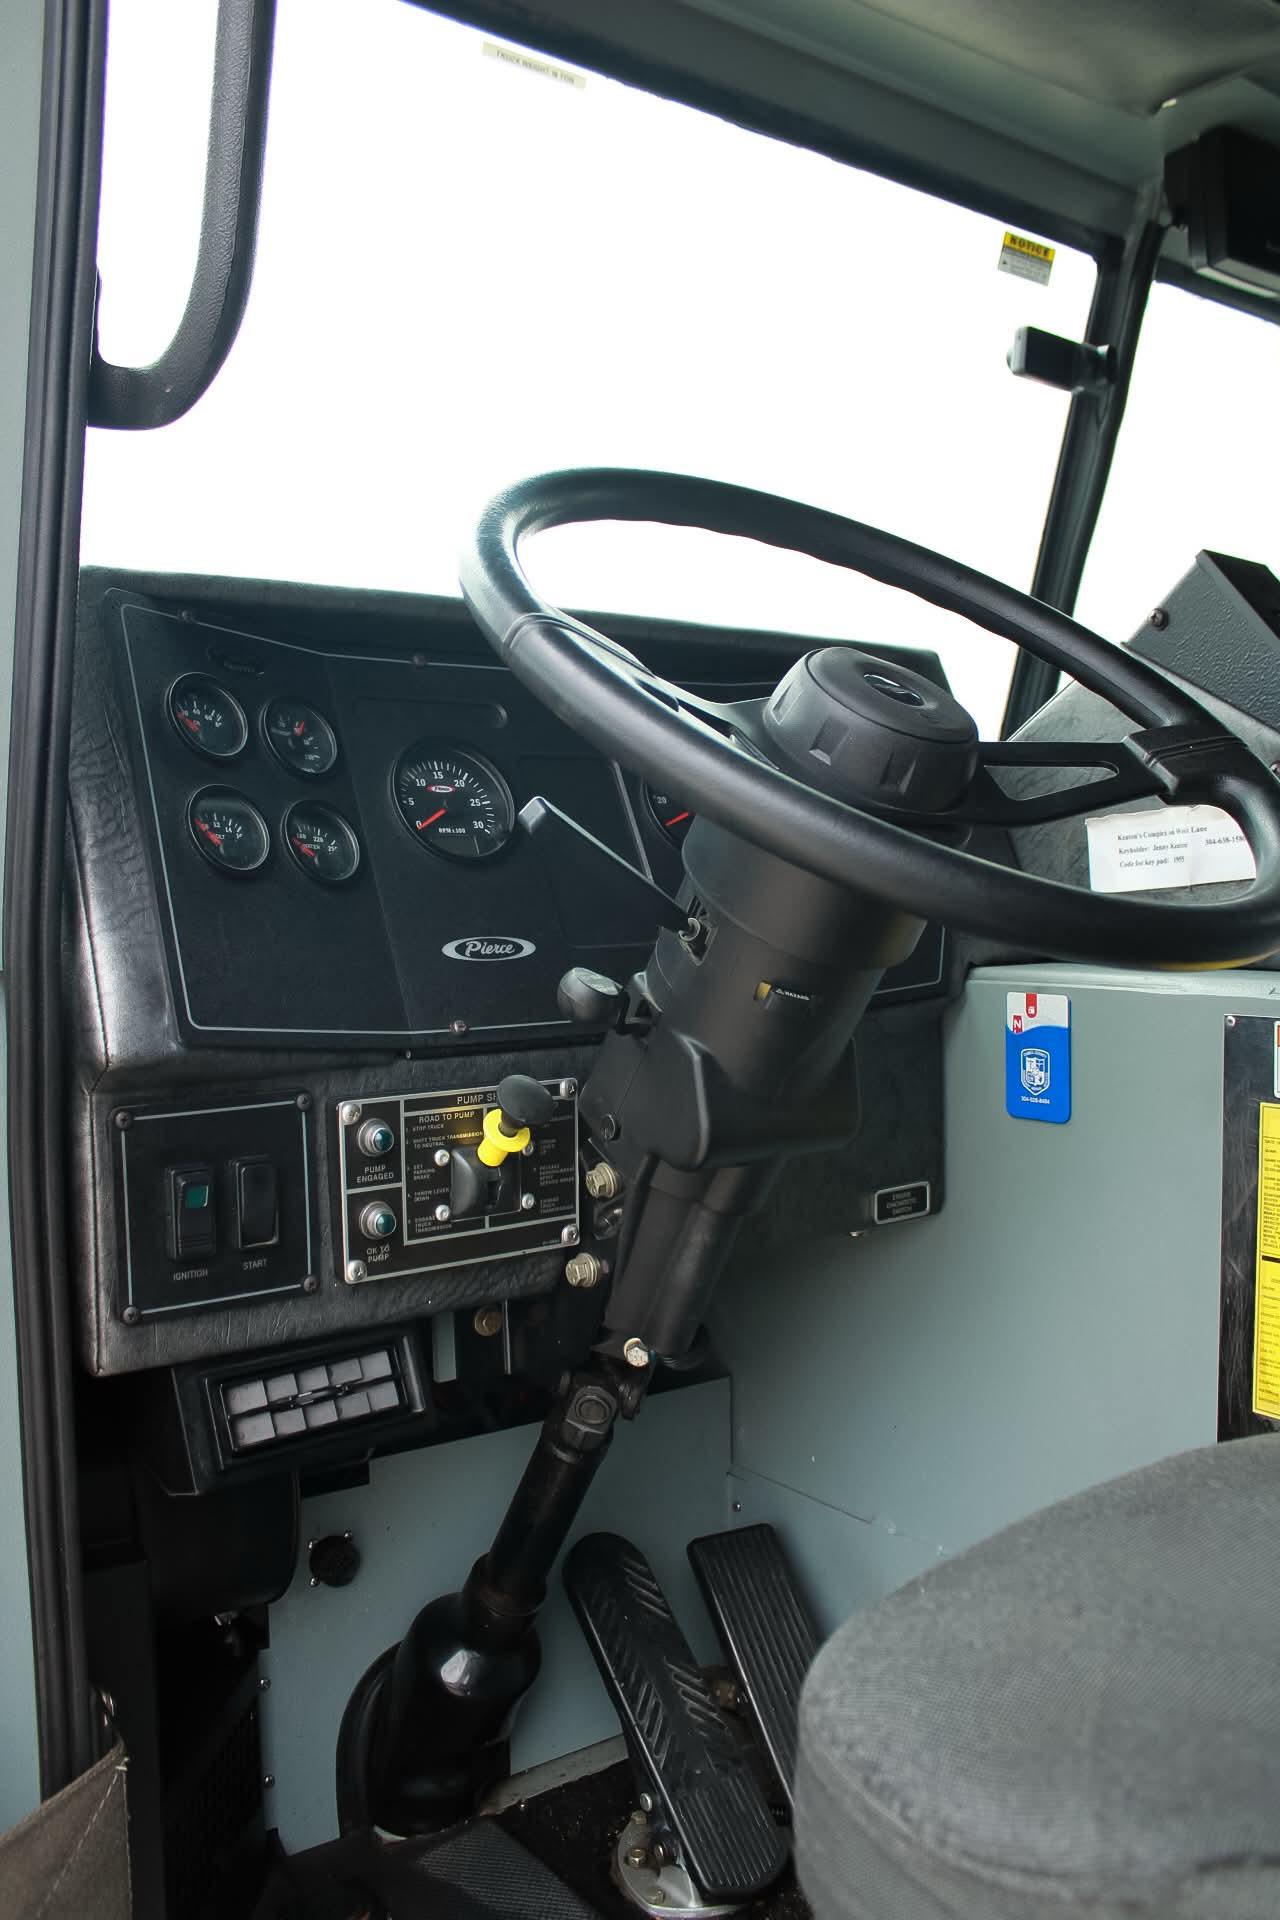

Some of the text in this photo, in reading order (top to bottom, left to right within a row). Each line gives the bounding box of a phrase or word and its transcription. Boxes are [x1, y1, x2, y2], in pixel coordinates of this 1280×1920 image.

[1010, 237, 1050, 257] NOTICE
[415, 778, 426, 787] 10
[454, 780, 465, 788] 20
[408, 798, 415, 806] 5
[469, 799, 481, 807] 25
[472, 821, 484, 829] 30
[465, 940, 515, 957] Pierce
[457, 1095, 483, 1105] PUMP
[419, 1110, 475, 1124] ROAD TO PUMP
[364, 1164, 386, 1174] PUMP
[356, 1172, 395, 1183] ENGAGED
[366, 1247, 377, 1255] OK
[367, 1253, 390, 1263] PUMP
[242, 1258, 268, 1271] START
[172, 1268, 208, 1281] IGNITION
